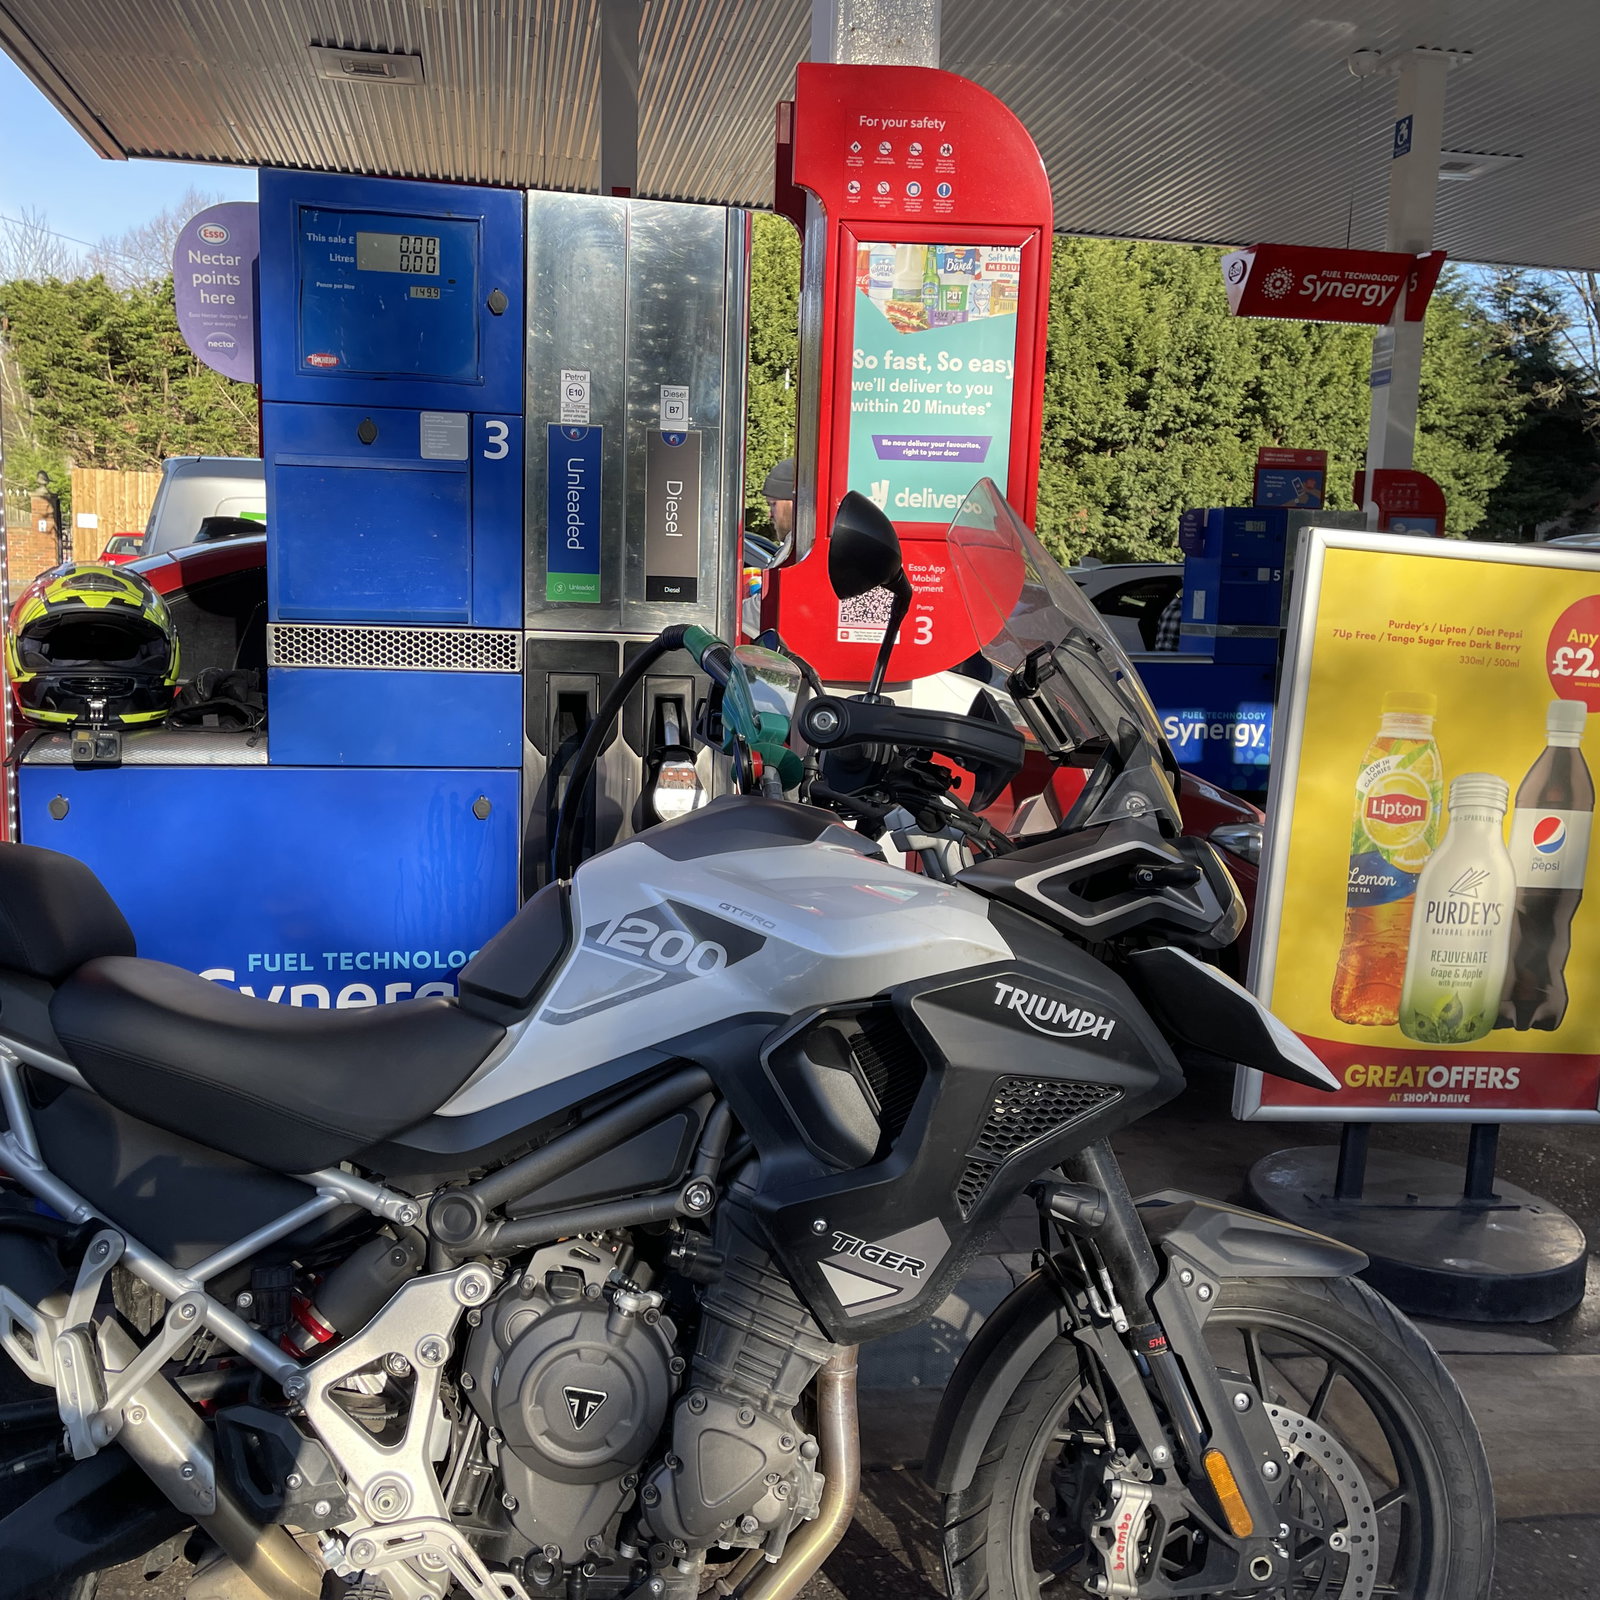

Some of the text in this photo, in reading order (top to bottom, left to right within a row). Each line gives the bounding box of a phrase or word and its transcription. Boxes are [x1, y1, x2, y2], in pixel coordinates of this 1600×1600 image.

[859, 115, 946, 132] For your safety
[203, 229, 225, 239] Esso
[306, 232, 355, 244] This sale £
[188, 249, 241, 266] Nectar
[329, 253, 354, 263] Litres
[192, 270, 240, 287] points
[1321, 270, 1399, 282] FUEL TECHNOLOGY
[1410, 272, 1418, 292] 5
[200, 289, 236, 305] here
[1299, 274, 1395, 307] Synergy
[207, 339, 235, 348] nectar
[852, 348, 1014, 380] So fast, So easy
[565, 373, 586, 381] Petrol
[663, 390, 687, 398] Diesel
[889, 378, 943, 394] deliver
[946, 381, 962, 395] to
[964, 384, 993, 399] you
[851, 398, 899, 413] within
[902, 399, 921, 414] 20
[483, 420, 510, 460] 3
[907, 440, 930, 448] deliver
[930, 441, 945, 449] your
[902, 448, 919, 457] right
[928, 450, 943, 458] your
[566, 458, 585, 550] Unleaded
[665, 480, 683, 537] Diesel
[908, 564, 946, 574] Esso App
[1273, 570, 1281, 581] 5
[912, 574, 940, 583] Mobile
[916, 604, 935, 612] Pump
[913, 616, 933, 645] 3
[1388, 620, 1429, 633] Purdey's
[1439, 624, 1467, 635] Lipton
[1476, 627, 1495, 637] Diet
[1498, 629, 1523, 640] Pepsi
[1567, 628, 1599, 648] Any
[1333, 629, 1352, 640] 7Up
[1355, 630, 1376, 640] Free
[1387, 633, 1415, 645] Tango
[1417, 636, 1444, 647] Sugar
[1447, 638, 1467, 648] Free
[1469, 640, 1492, 650] Dark
[1495, 642, 1521, 653] Berry
[1459, 656, 1485, 665] 330ml
[1494, 658, 1520, 668] 500ml
[1206, 712, 1266, 720] TECHNOLOGY
[1164, 716, 1265, 747] Synergy
[1365, 766, 1391, 788] CALORIES
[1366, 762, 1381, 776] LOW
[1372, 800, 1422, 819] Lipton
[1532, 860, 1560, 873] pepsi
[1348, 867, 1397, 887] Lemon
[1425, 901, 1504, 926] PURDEY'S
[1432, 928, 1463, 937] NATURAL
[596, 917, 727, 976] 1200
[248, 950, 480, 972] FUEL TECHNOLO
[1430, 950, 1488, 964] REJUVENATE
[1430, 967, 1483, 979] Grape & Apple
[994, 981, 1116, 1041] TRIUMPH
[1389, 1093, 1402, 1102] AT
[832, 1230, 926, 1279] TIGER
[1113, 1512, 1132, 1570] brembo
